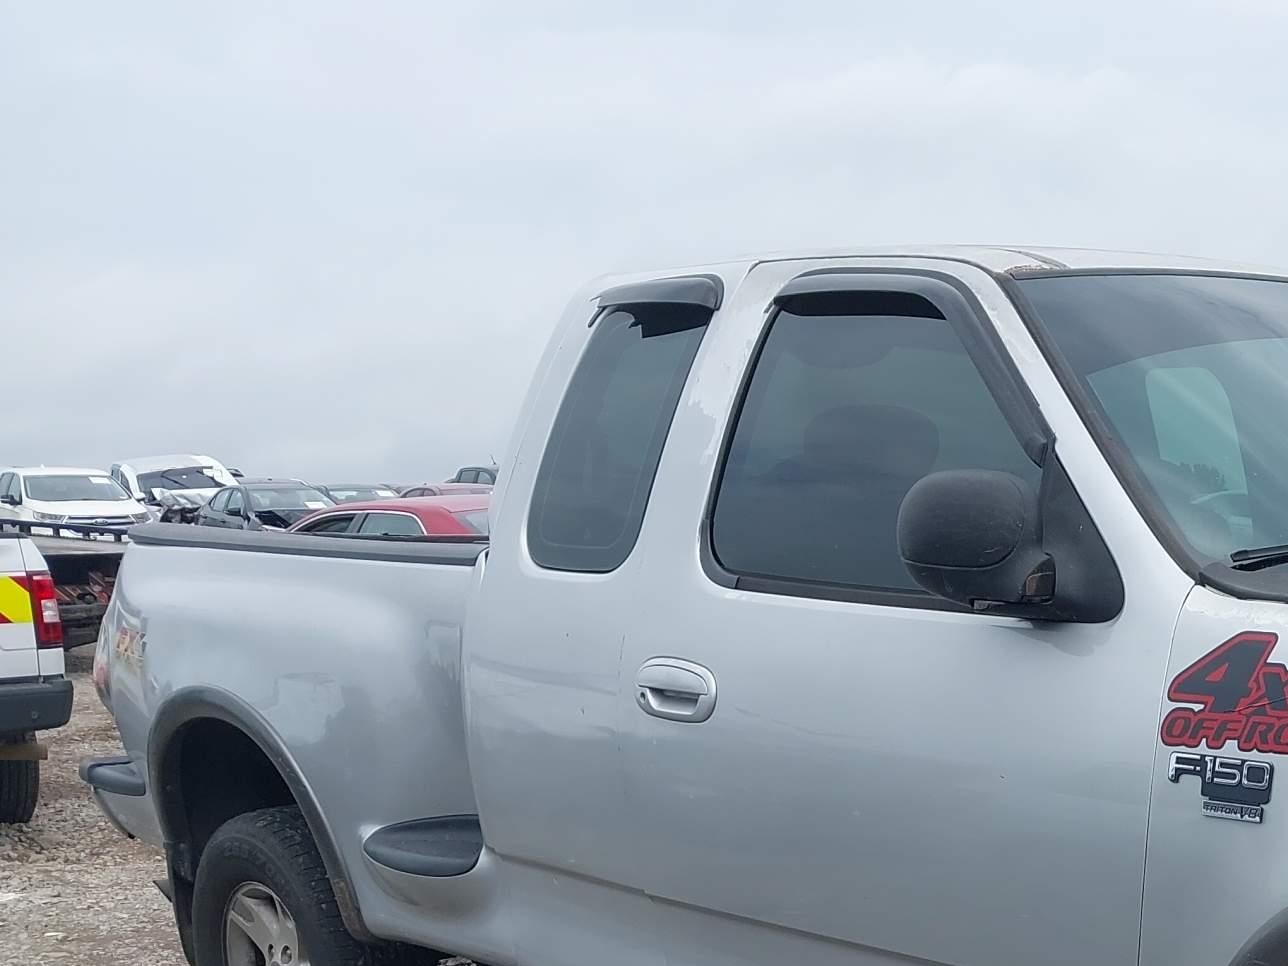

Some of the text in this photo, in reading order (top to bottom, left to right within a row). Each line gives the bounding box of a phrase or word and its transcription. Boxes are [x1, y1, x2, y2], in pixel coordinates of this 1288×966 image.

[1168, 752, 1271, 789] F-150
[1204, 804, 1259, 819] TRITON V8
